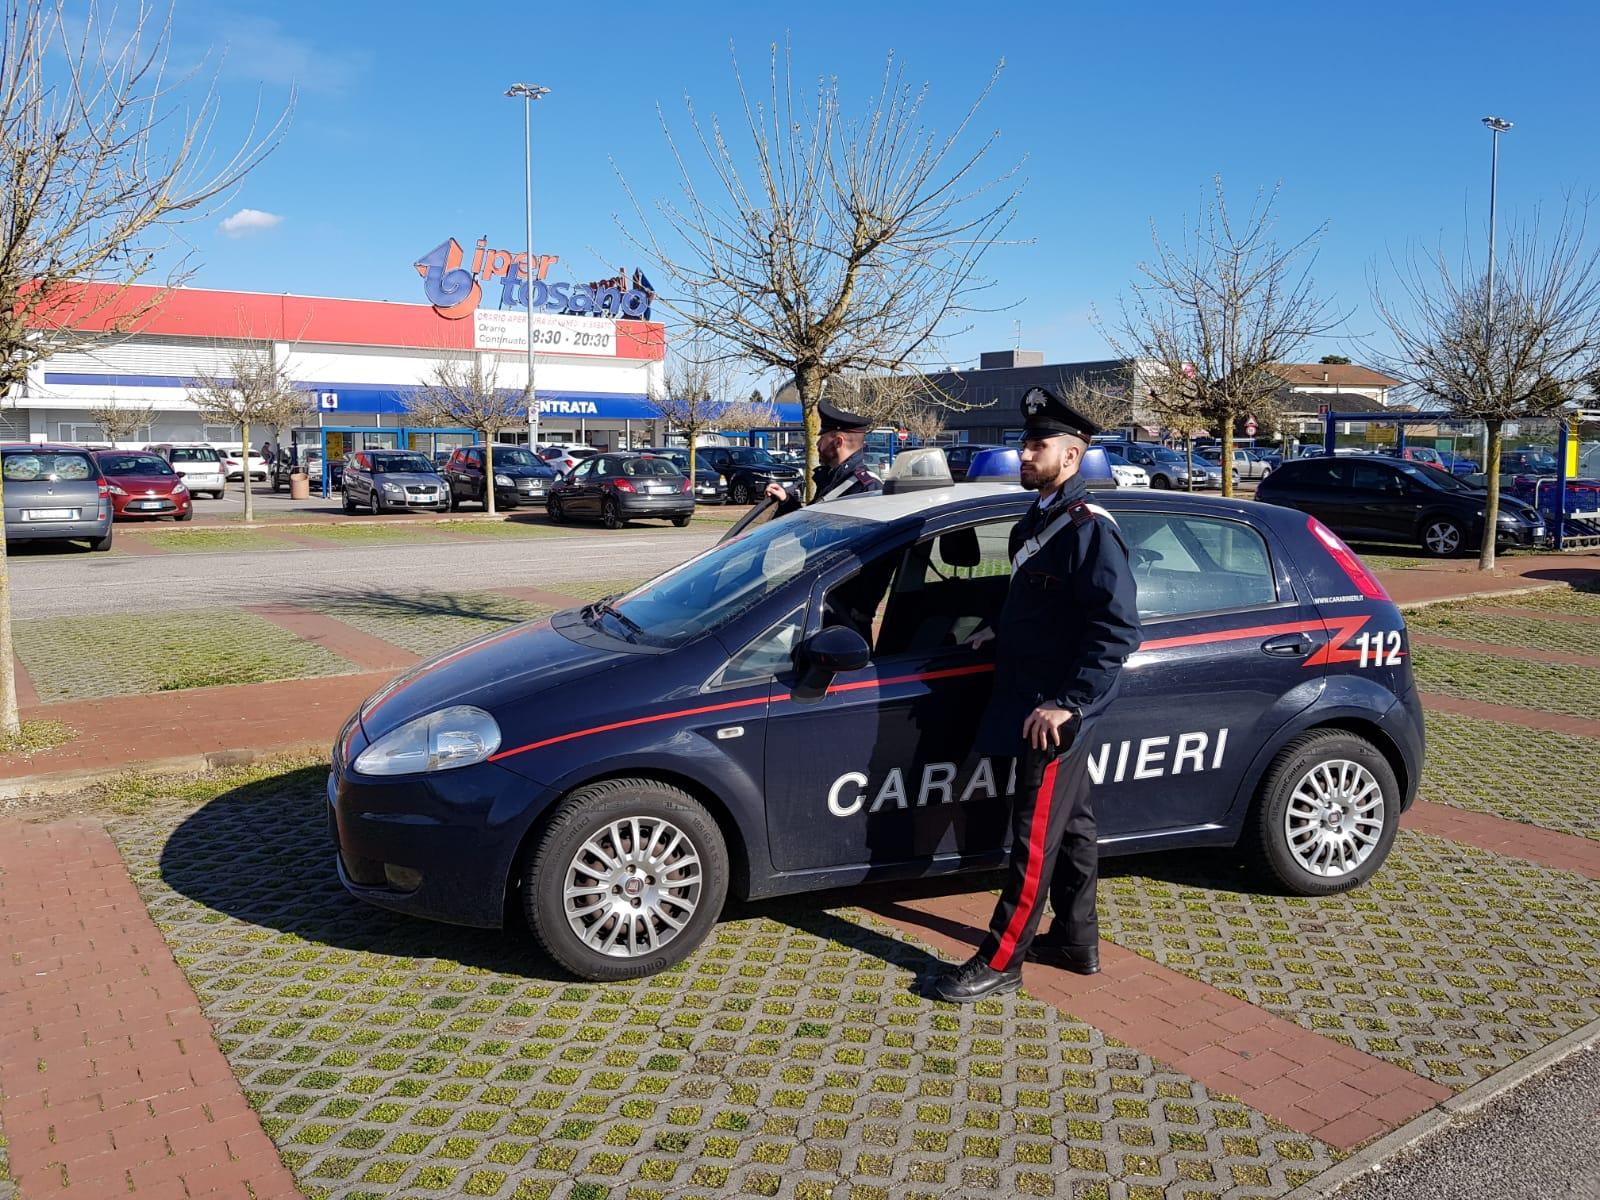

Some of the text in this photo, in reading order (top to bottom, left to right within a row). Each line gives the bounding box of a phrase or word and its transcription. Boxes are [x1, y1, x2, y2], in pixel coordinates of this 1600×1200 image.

[471, 239, 559, 281] iper
[500, 263, 649, 317] tosano
[479, 323, 506, 334] Orario
[508, 314, 546, 325] APERURA
[532, 329, 562, 345] 8:30
[573, 331, 610, 348] 20:30
[1356, 630, 1402, 669] 112
[827, 728, 1229, 817] CARANIERI
